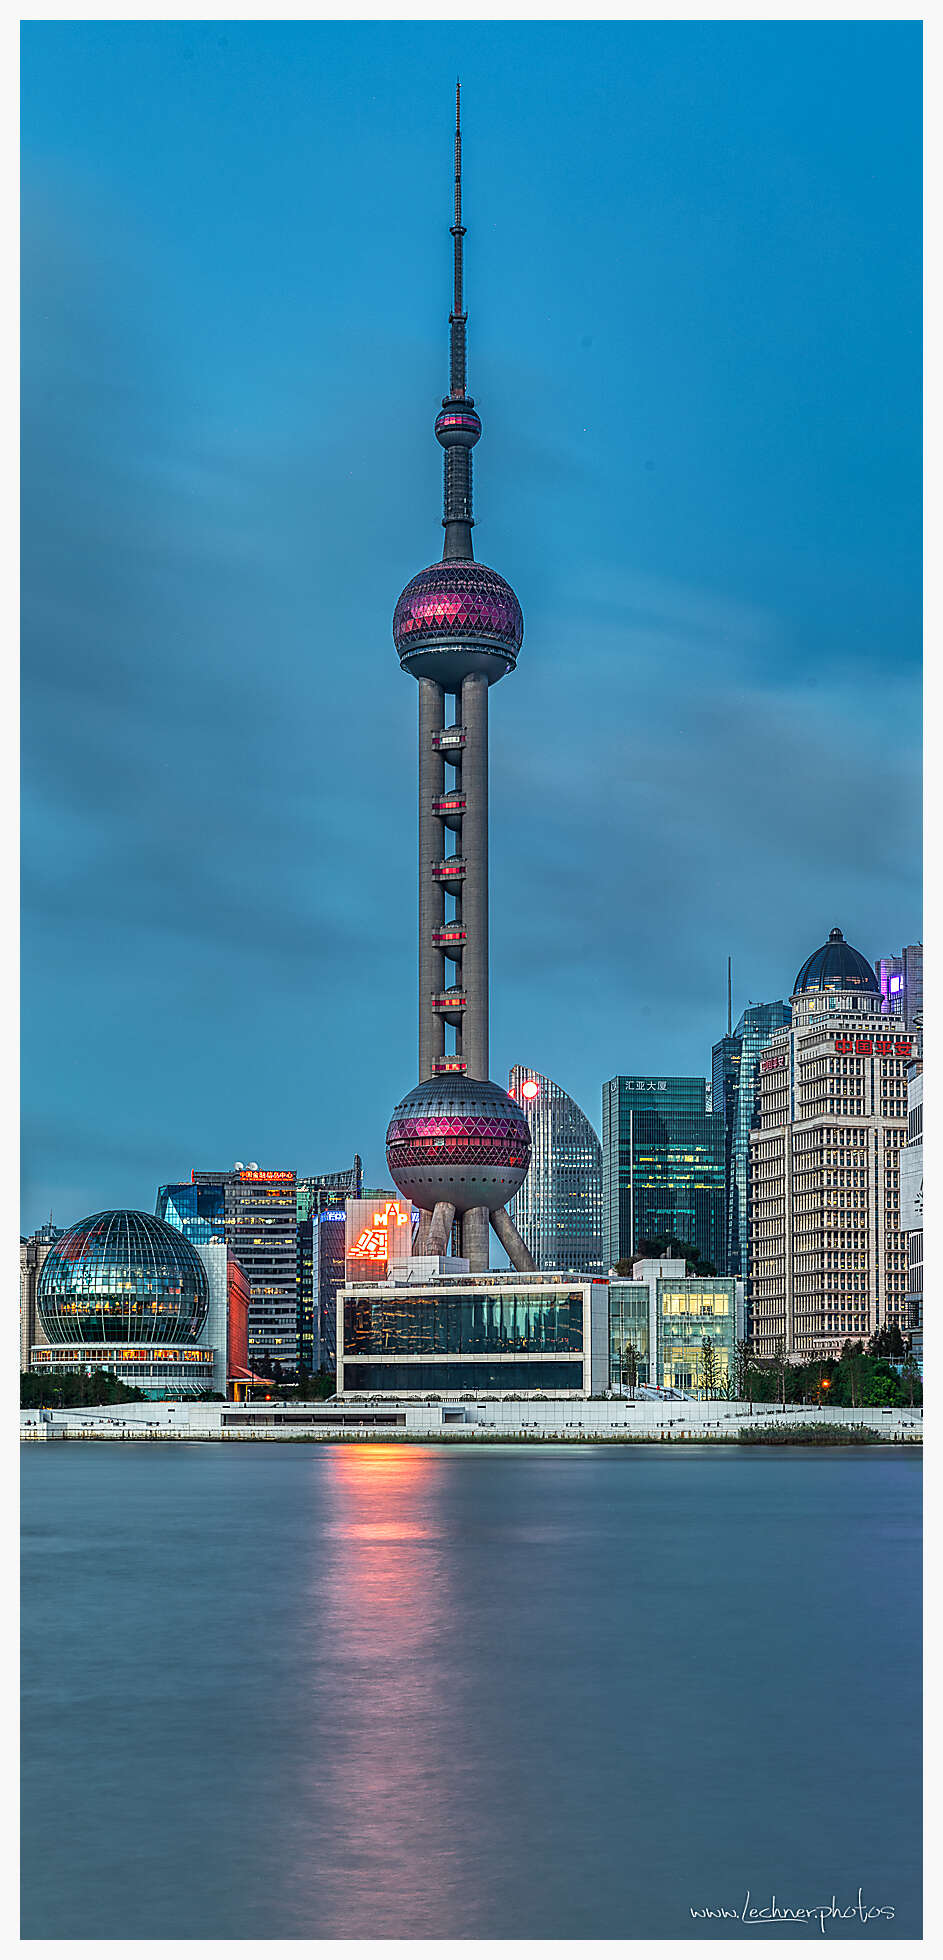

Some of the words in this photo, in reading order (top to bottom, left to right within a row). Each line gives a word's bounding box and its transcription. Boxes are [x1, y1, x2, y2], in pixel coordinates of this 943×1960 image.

[835, 1039, 913, 1056] 中国平安
[625, 1081, 668, 1091] 汇亚大厦
